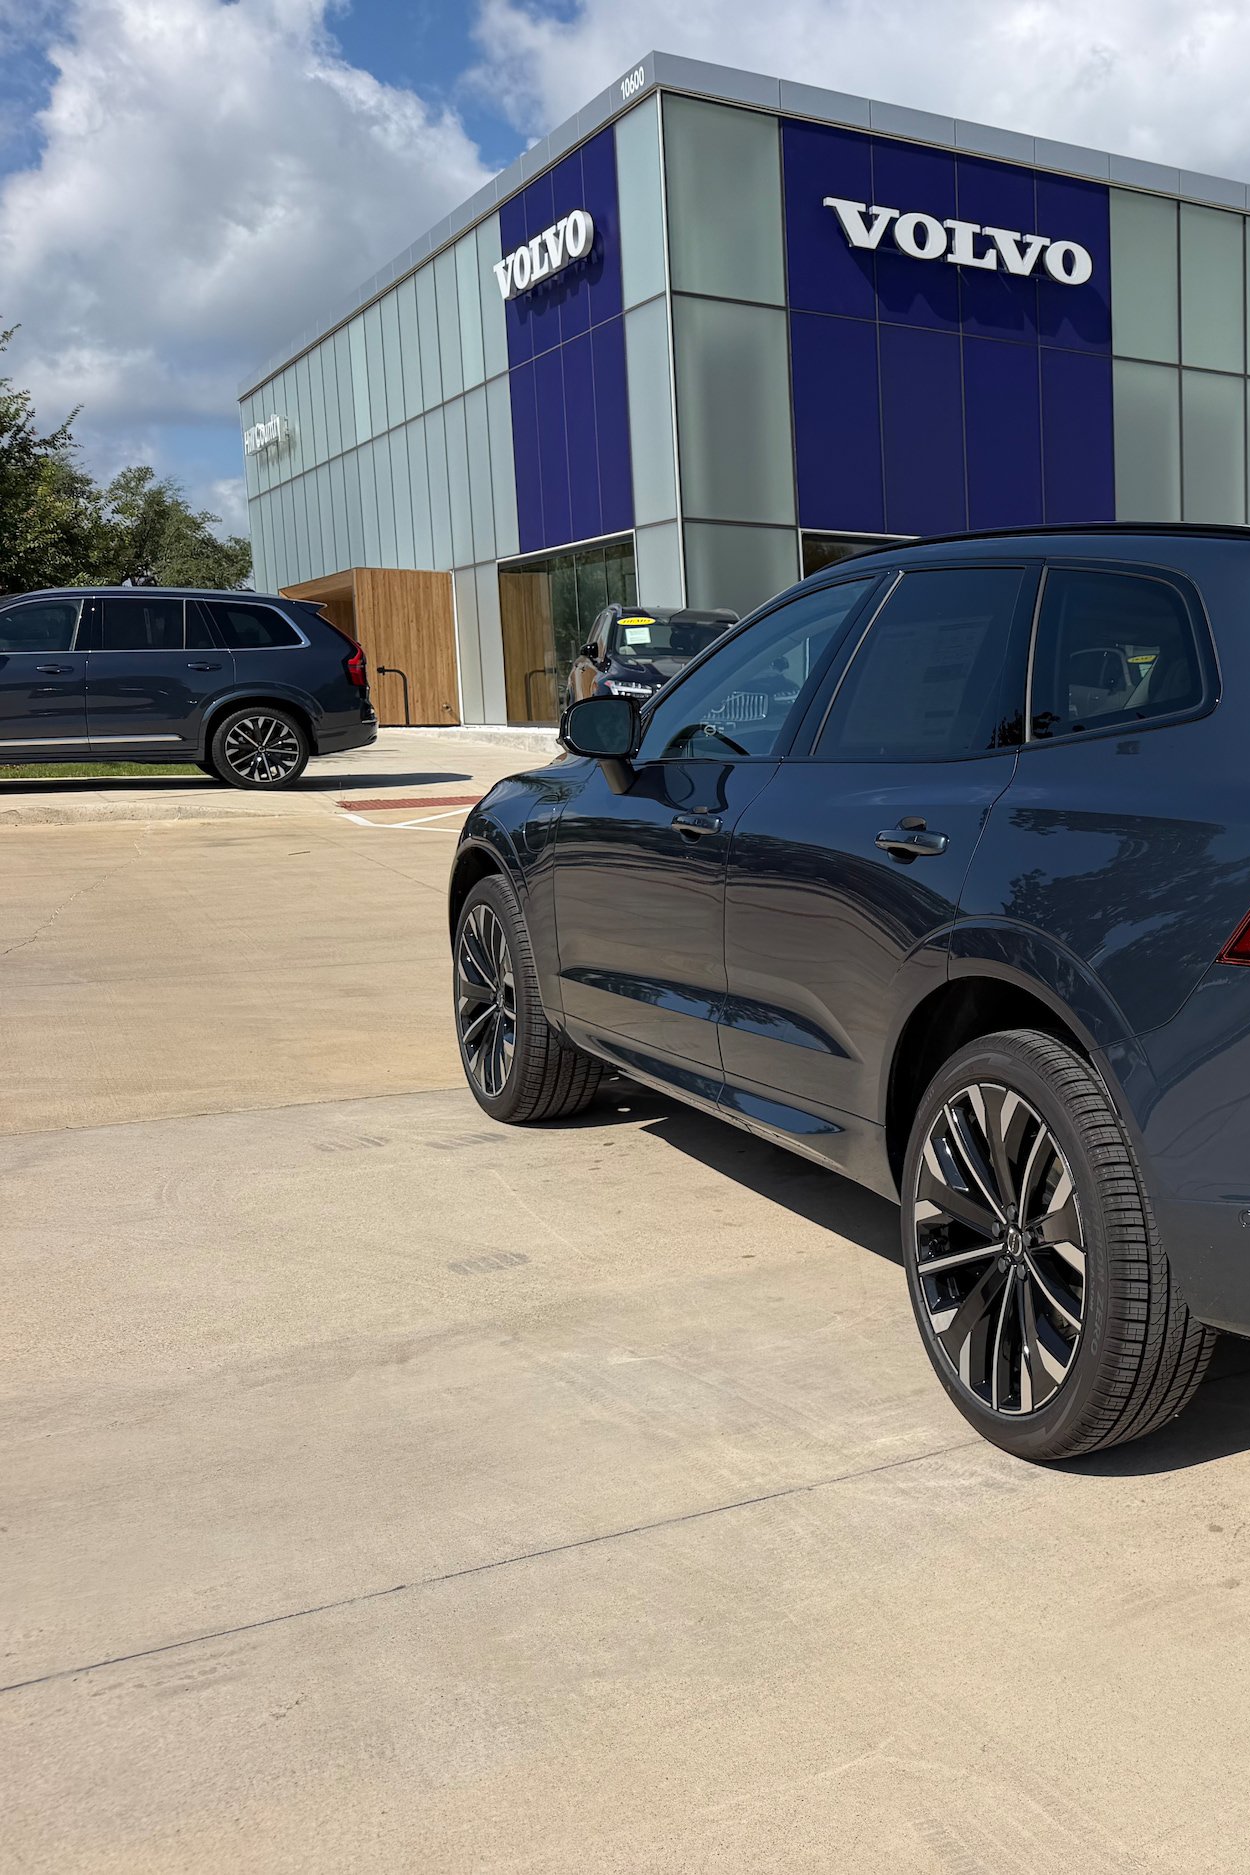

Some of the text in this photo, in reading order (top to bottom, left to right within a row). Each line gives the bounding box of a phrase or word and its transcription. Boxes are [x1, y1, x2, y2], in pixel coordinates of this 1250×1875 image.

[620, 65, 645, 101] 10600
[493, 209, 594, 300] VOLVO
[823, 196, 1093, 286] VOLVO
